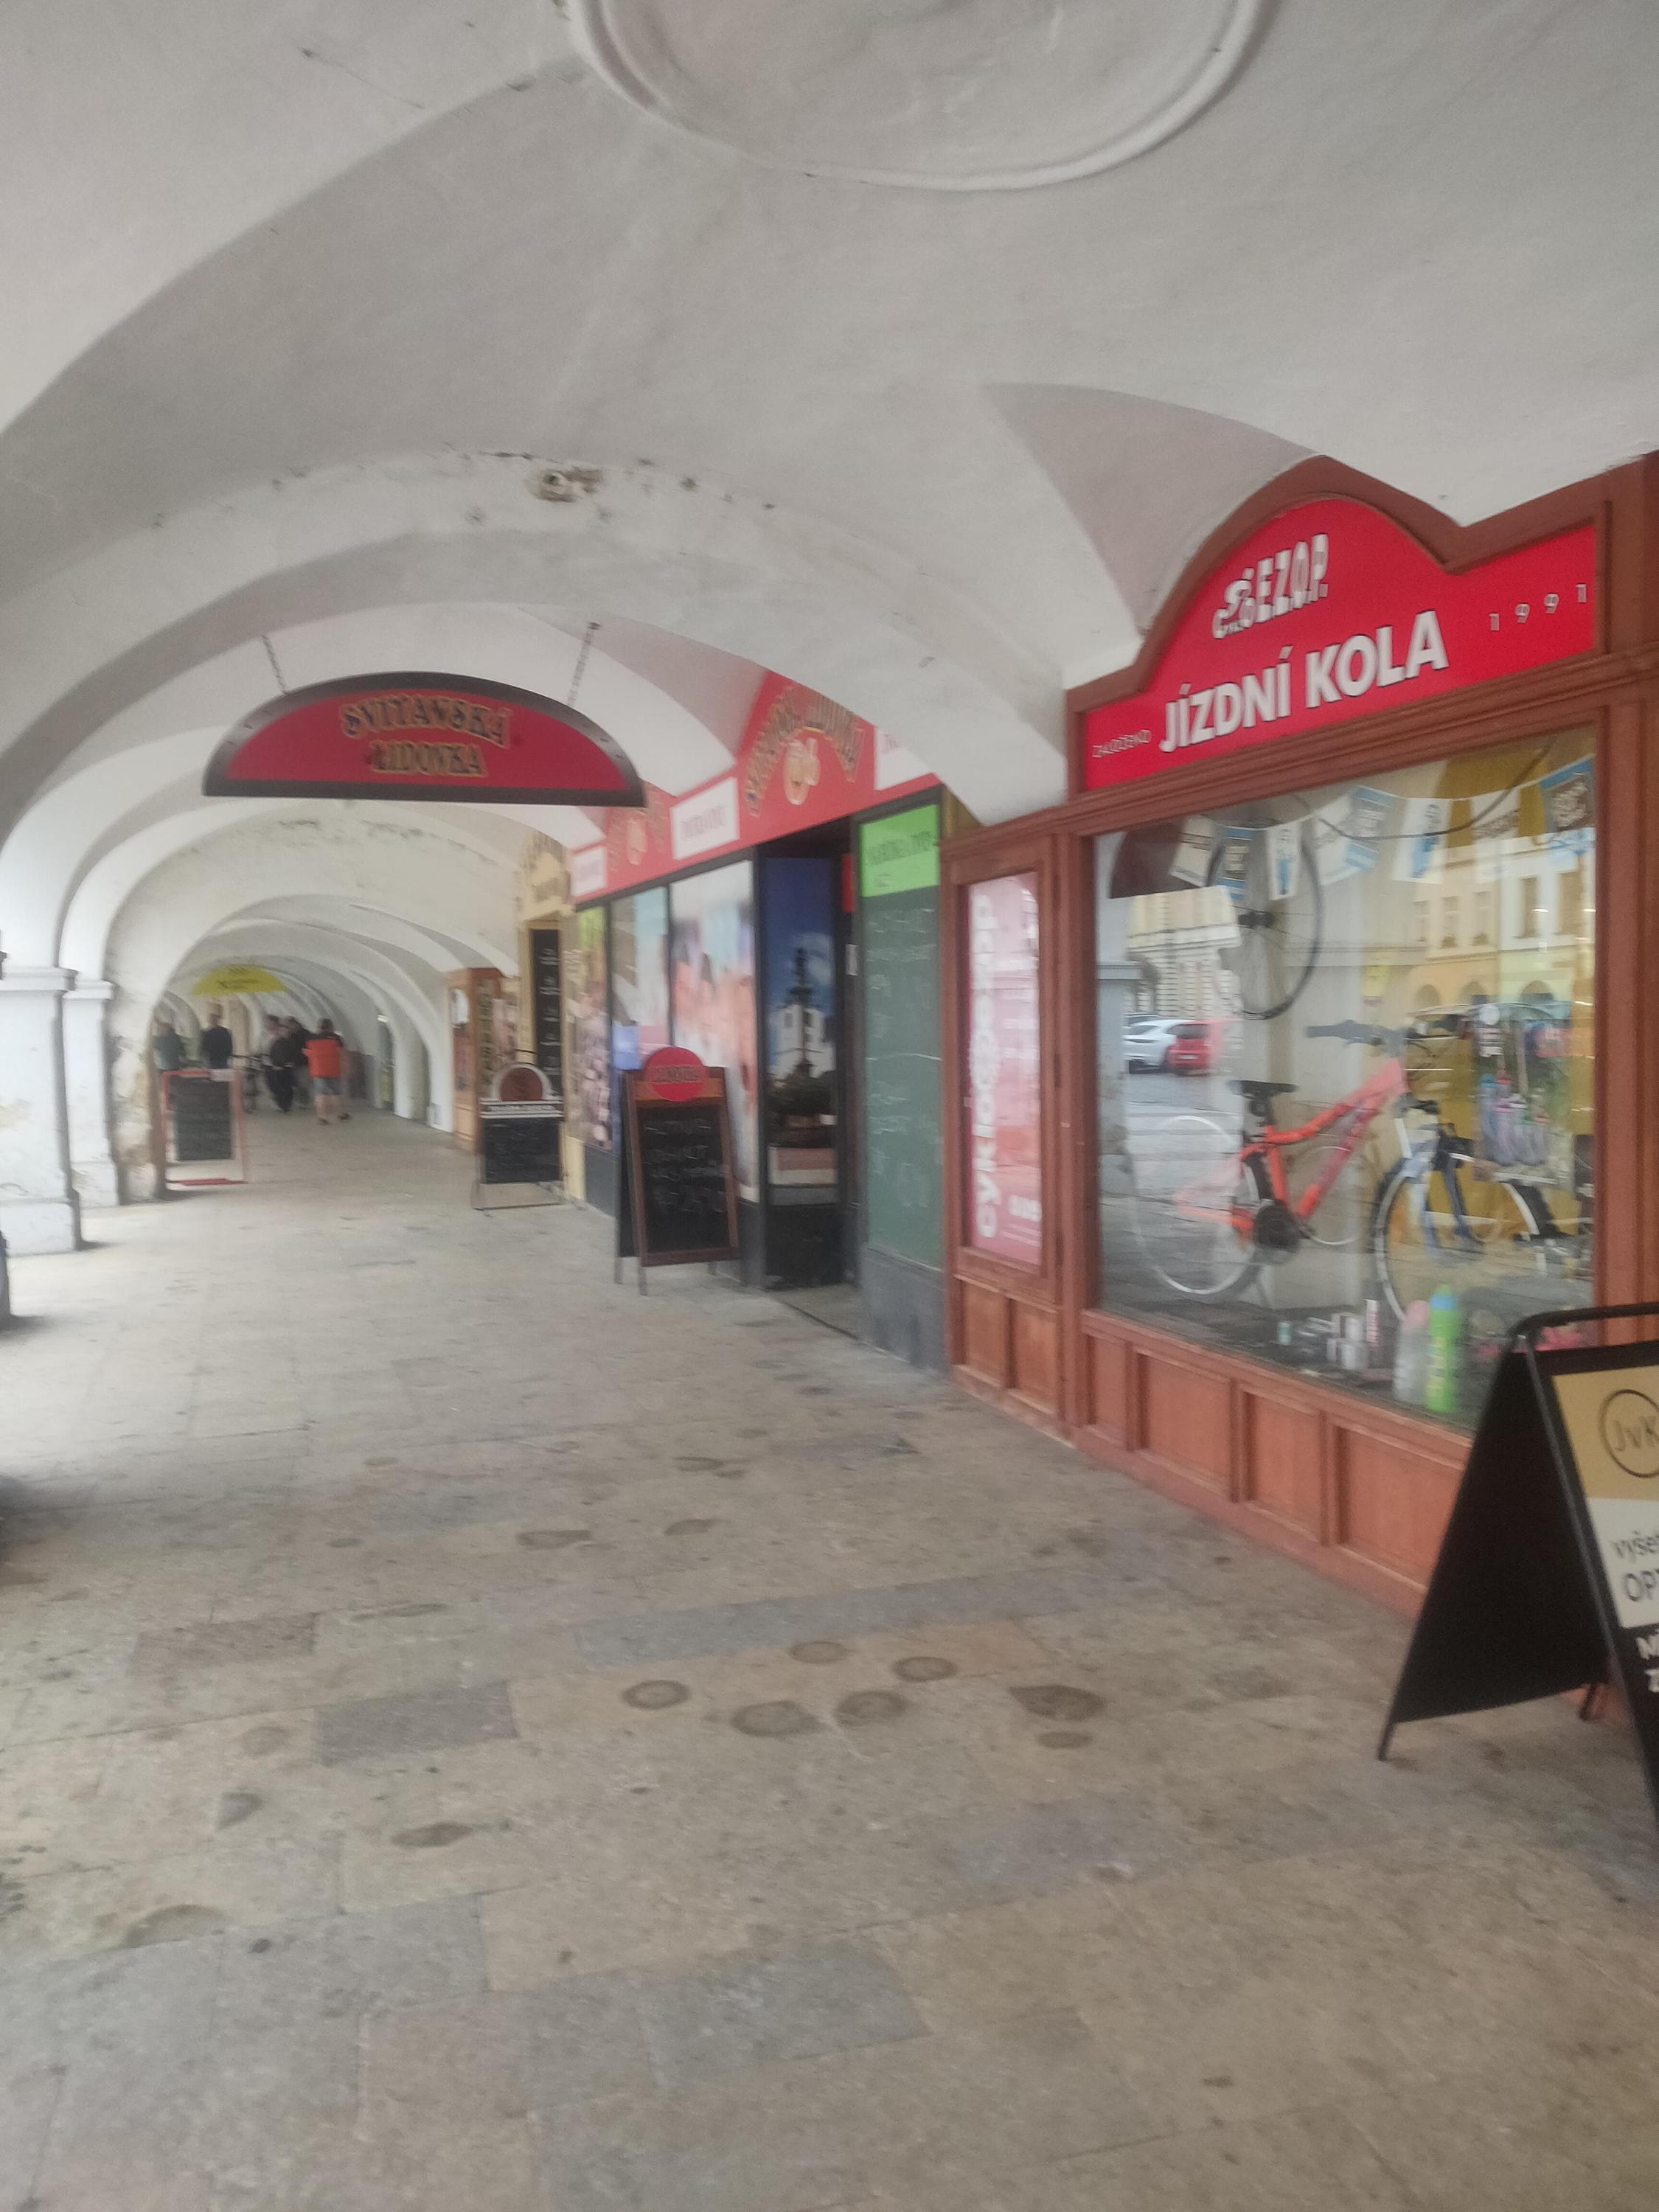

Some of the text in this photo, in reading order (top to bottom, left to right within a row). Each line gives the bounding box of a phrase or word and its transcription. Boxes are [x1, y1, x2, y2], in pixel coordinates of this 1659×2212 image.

[1489, 582, 1587, 631] 1991
[1158, 609, 1450, 752] JÍZDNÍ KOLA
